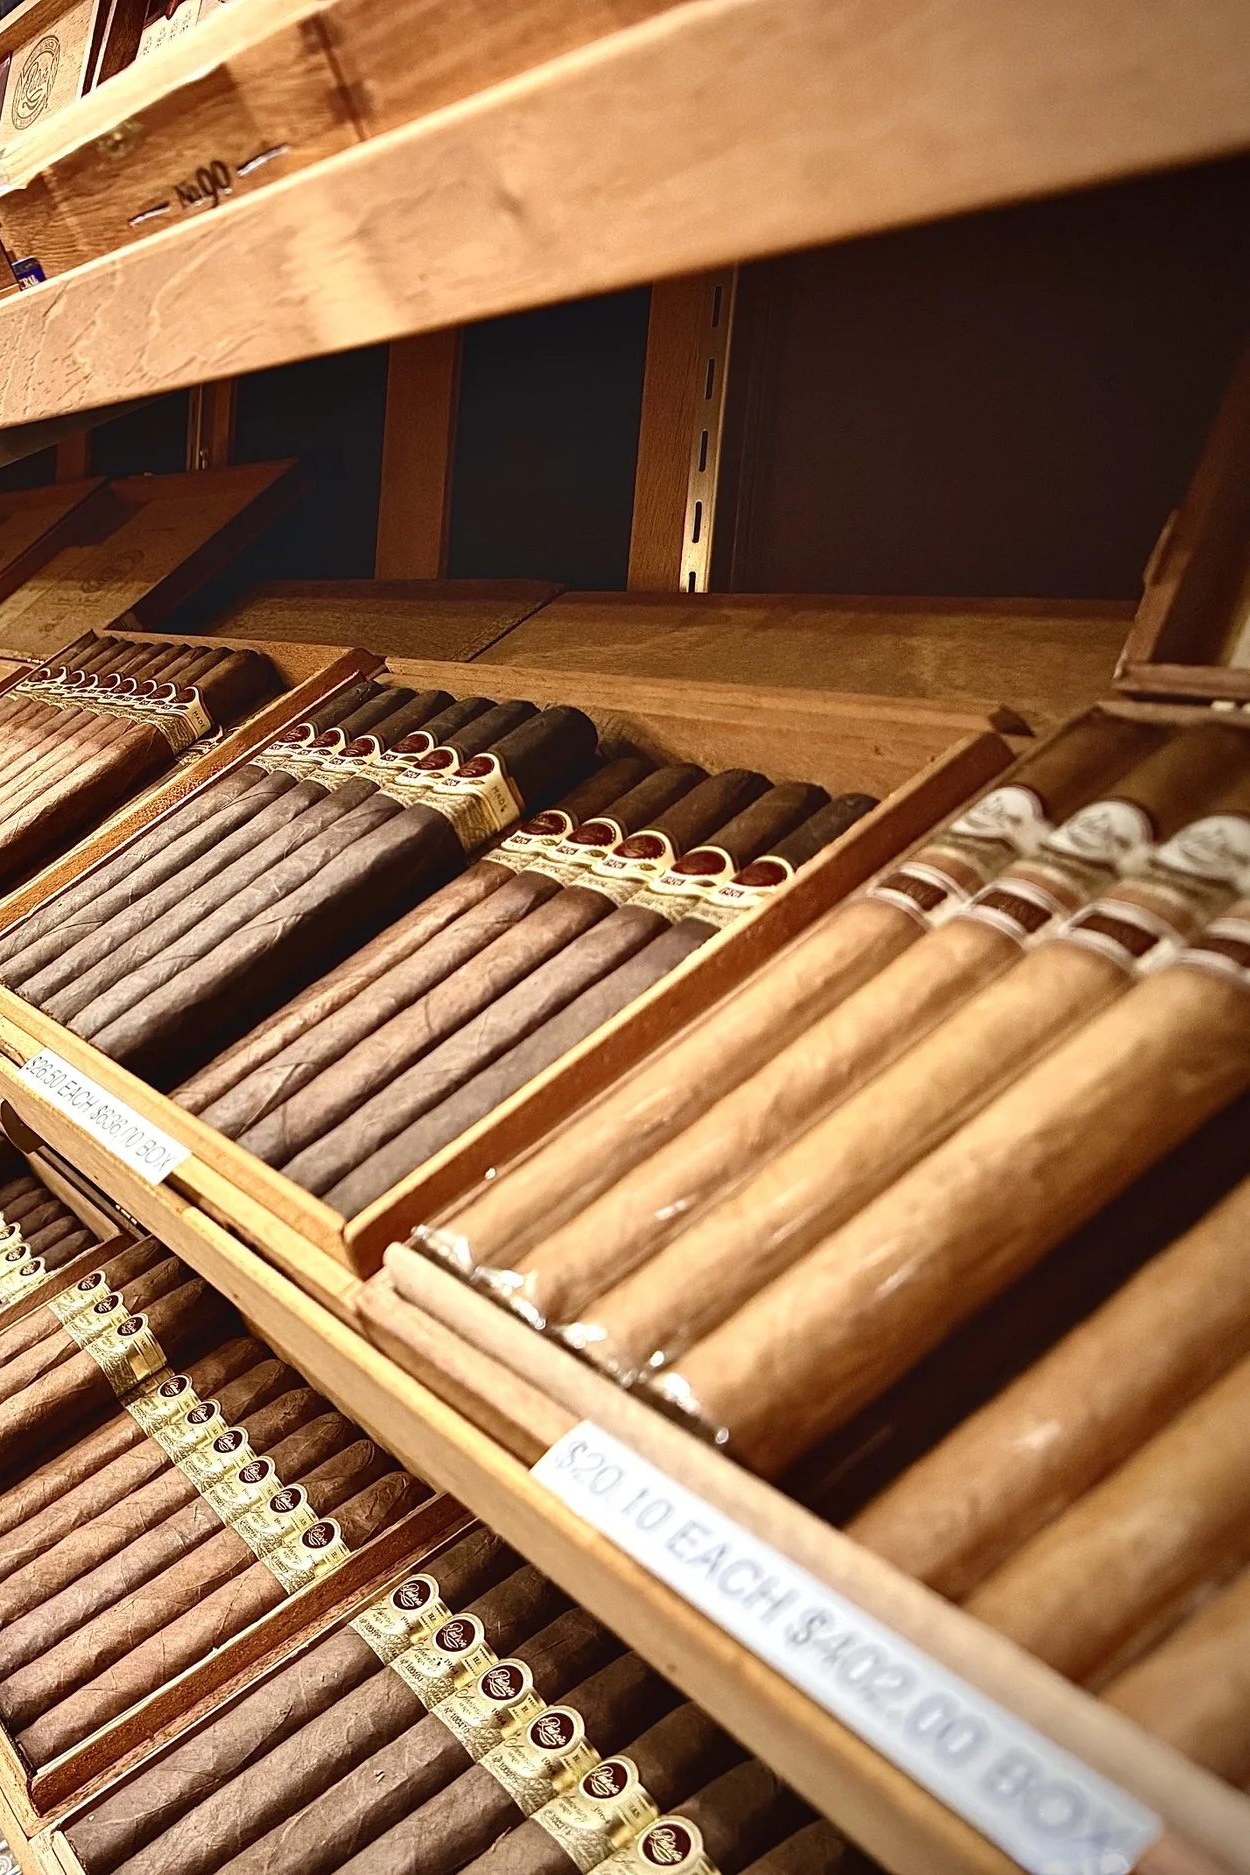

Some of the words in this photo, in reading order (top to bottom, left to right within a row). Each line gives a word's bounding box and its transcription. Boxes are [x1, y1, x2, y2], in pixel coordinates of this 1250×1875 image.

[26, 1056, 67, 1089] $26.50
[57, 1080, 100, 1113] EACH
[90, 1105, 144, 1148] $636.00
[136, 1139, 177, 1173] BOX
[665, 1520, 800, 1626] EACH
[784, 1607, 991, 1770] $402.00
[979, 1746, 1135, 1860] BOX
